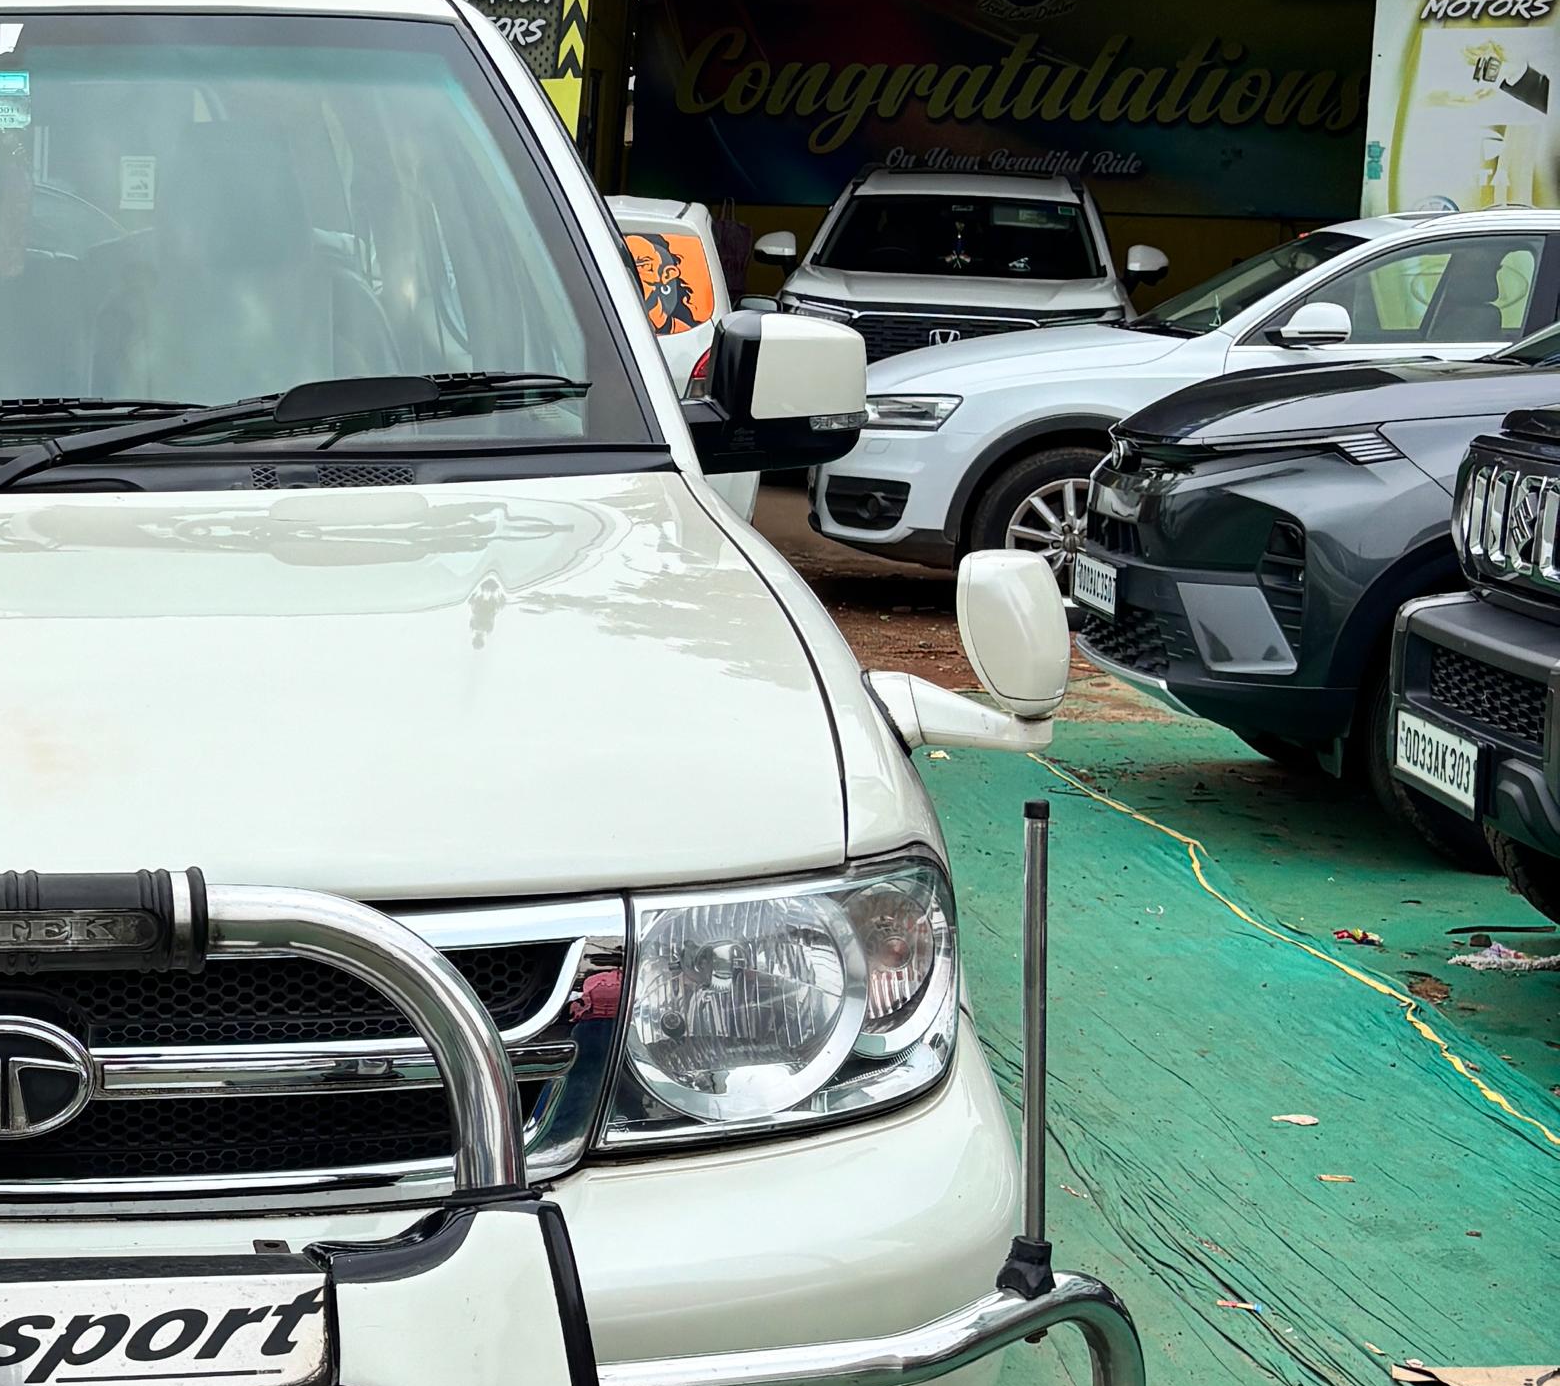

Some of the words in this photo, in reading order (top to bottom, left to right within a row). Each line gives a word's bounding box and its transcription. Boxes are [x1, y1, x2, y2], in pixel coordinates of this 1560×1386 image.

[676, 26, 1370, 155] Congratulations
[886, 146, 916, 169] On
[924, 147, 981, 171] Your
[989, 148, 1089, 174] Beautiful
[1093, 151, 1143, 174] Ride
